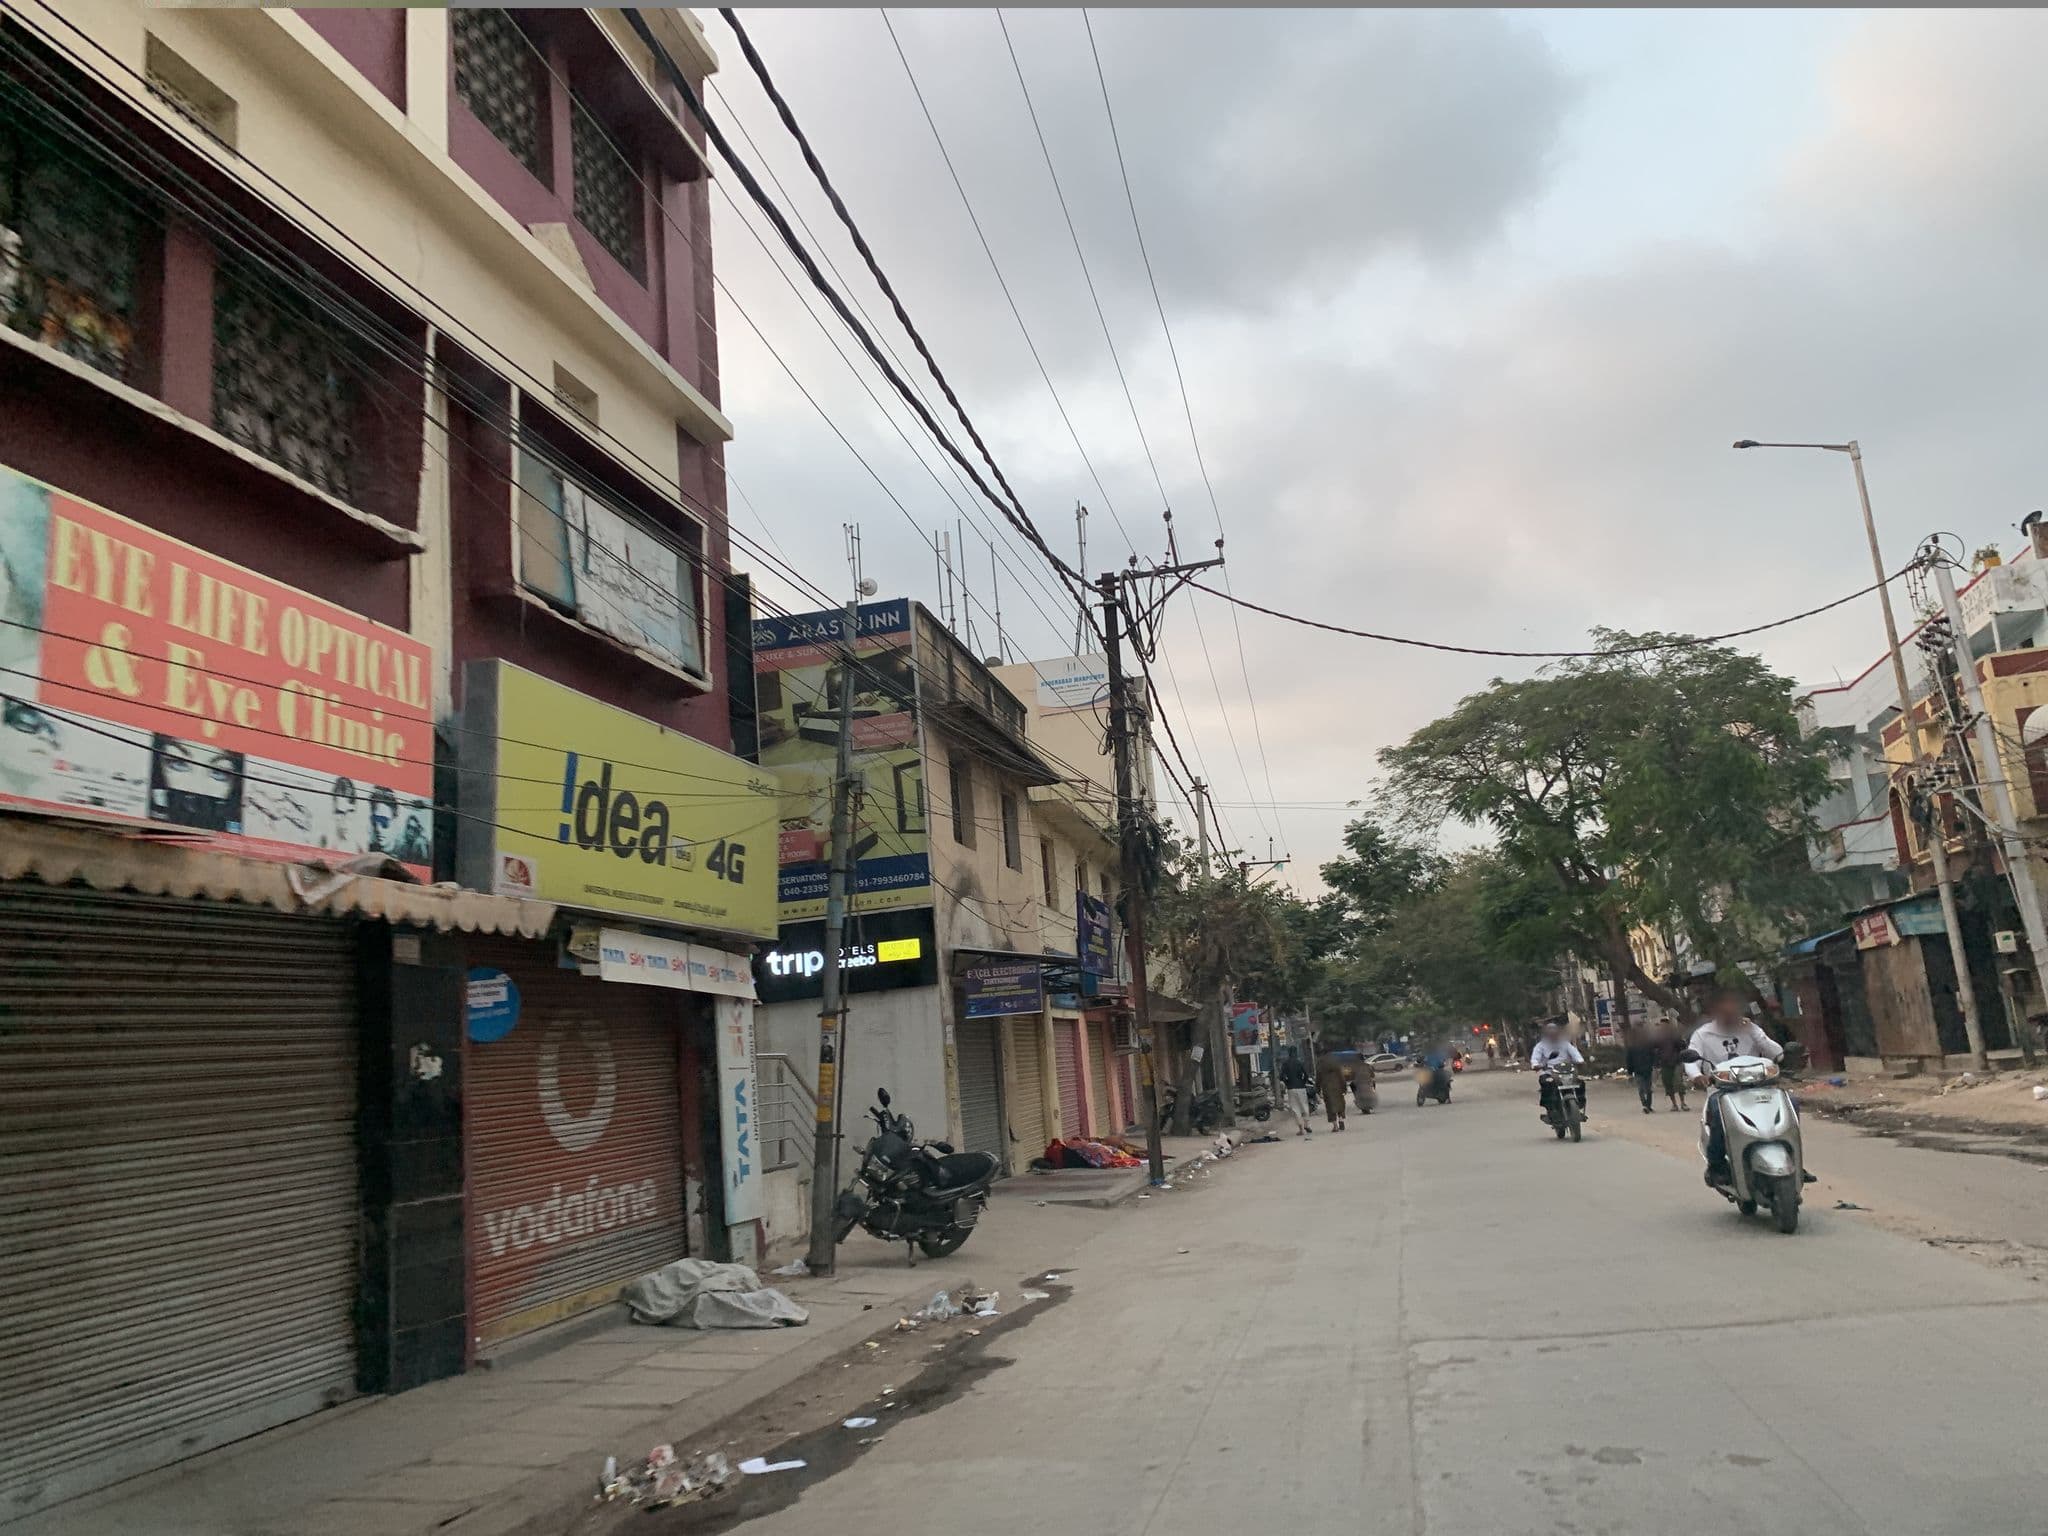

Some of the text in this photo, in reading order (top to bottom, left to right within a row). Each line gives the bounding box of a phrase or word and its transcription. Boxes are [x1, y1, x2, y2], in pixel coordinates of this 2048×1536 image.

[51, 514, 428, 711] EYE LIFE OPTICAL
[869, 610, 900, 629] INN
[85, 622, 406, 768] & Eye Clinic
[706, 837, 745, 885] 4G
[766, 950, 824, 977] trip
[734, 1078, 750, 1184] TATA
[483, 1174, 657, 1257] vodafone
